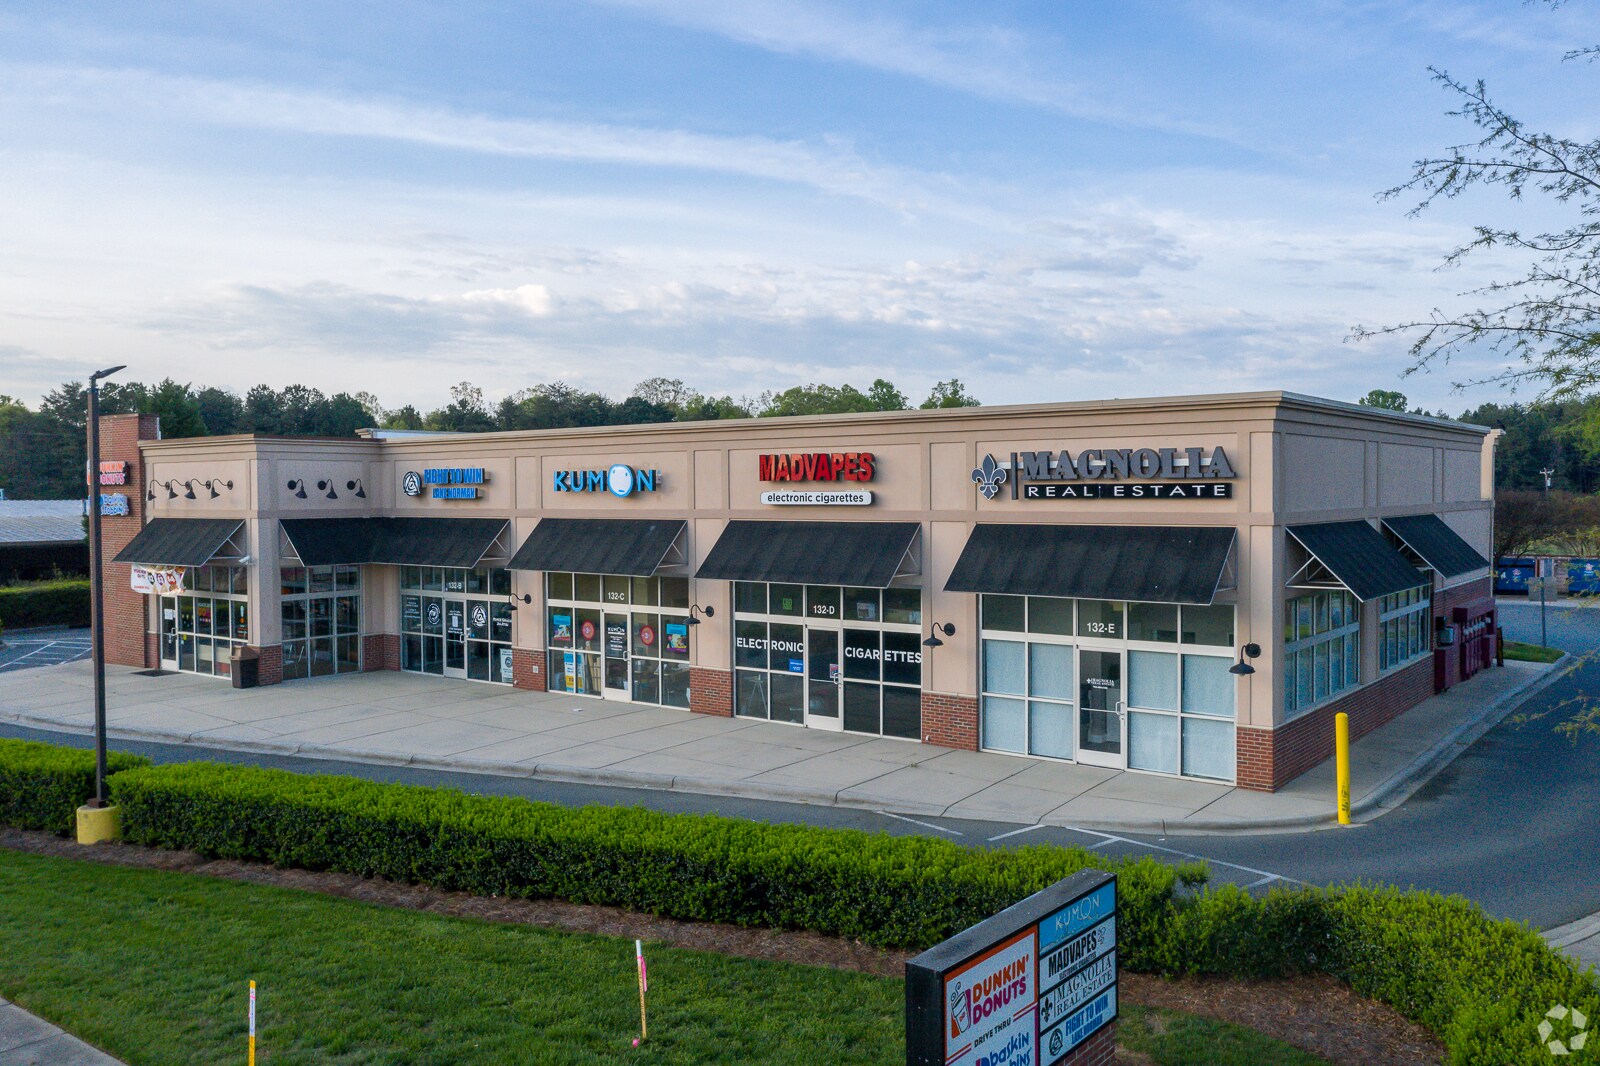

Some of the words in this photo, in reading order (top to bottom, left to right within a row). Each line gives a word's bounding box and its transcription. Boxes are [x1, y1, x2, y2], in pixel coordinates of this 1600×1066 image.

[450, 468, 462, 484] TO
[463, 467, 485, 484] WIN
[759, 452, 876, 483] MADVAPES
[1020, 446, 1236, 480] MAGNOLIA
[98, 473, 125, 485] ONUTS
[553, 463, 657, 498] KUMON
[1028, 486, 1094, 497] REAL
[1113, 484, 1226, 496] ESTATE
[767, 492, 813, 503] electronic
[815, 492, 864, 505] cigarettes
[607, 592, 625, 601] 132-C
[813, 605, 835, 615] 132-D
[1086, 622, 1116, 634] 132-E
[736, 637, 804, 654] ELECTRONIC
[844, 646, 922, 664] CIGARETTES
[1055, 894, 1100, 931] KUMON
[1048, 930, 1097, 978] MADVAPES
[972, 953, 1029, 1004] DUNKIN'
[1056, 992, 1080, 1017] REAL
[1082, 969, 1113, 998] ESTATE
[1057, 955, 1112, 1003] MAGNOLIA
[972, 975, 1027, 1025] DONUTS
[1065, 1009, 1085, 1037] FIGHT
[1085, 1003, 1094, 1022] TO
[1094, 993, 1109, 1014] WIN
[973, 1028, 994, 1048] DRIVE
[994, 1017, 1012, 1035] THRU
